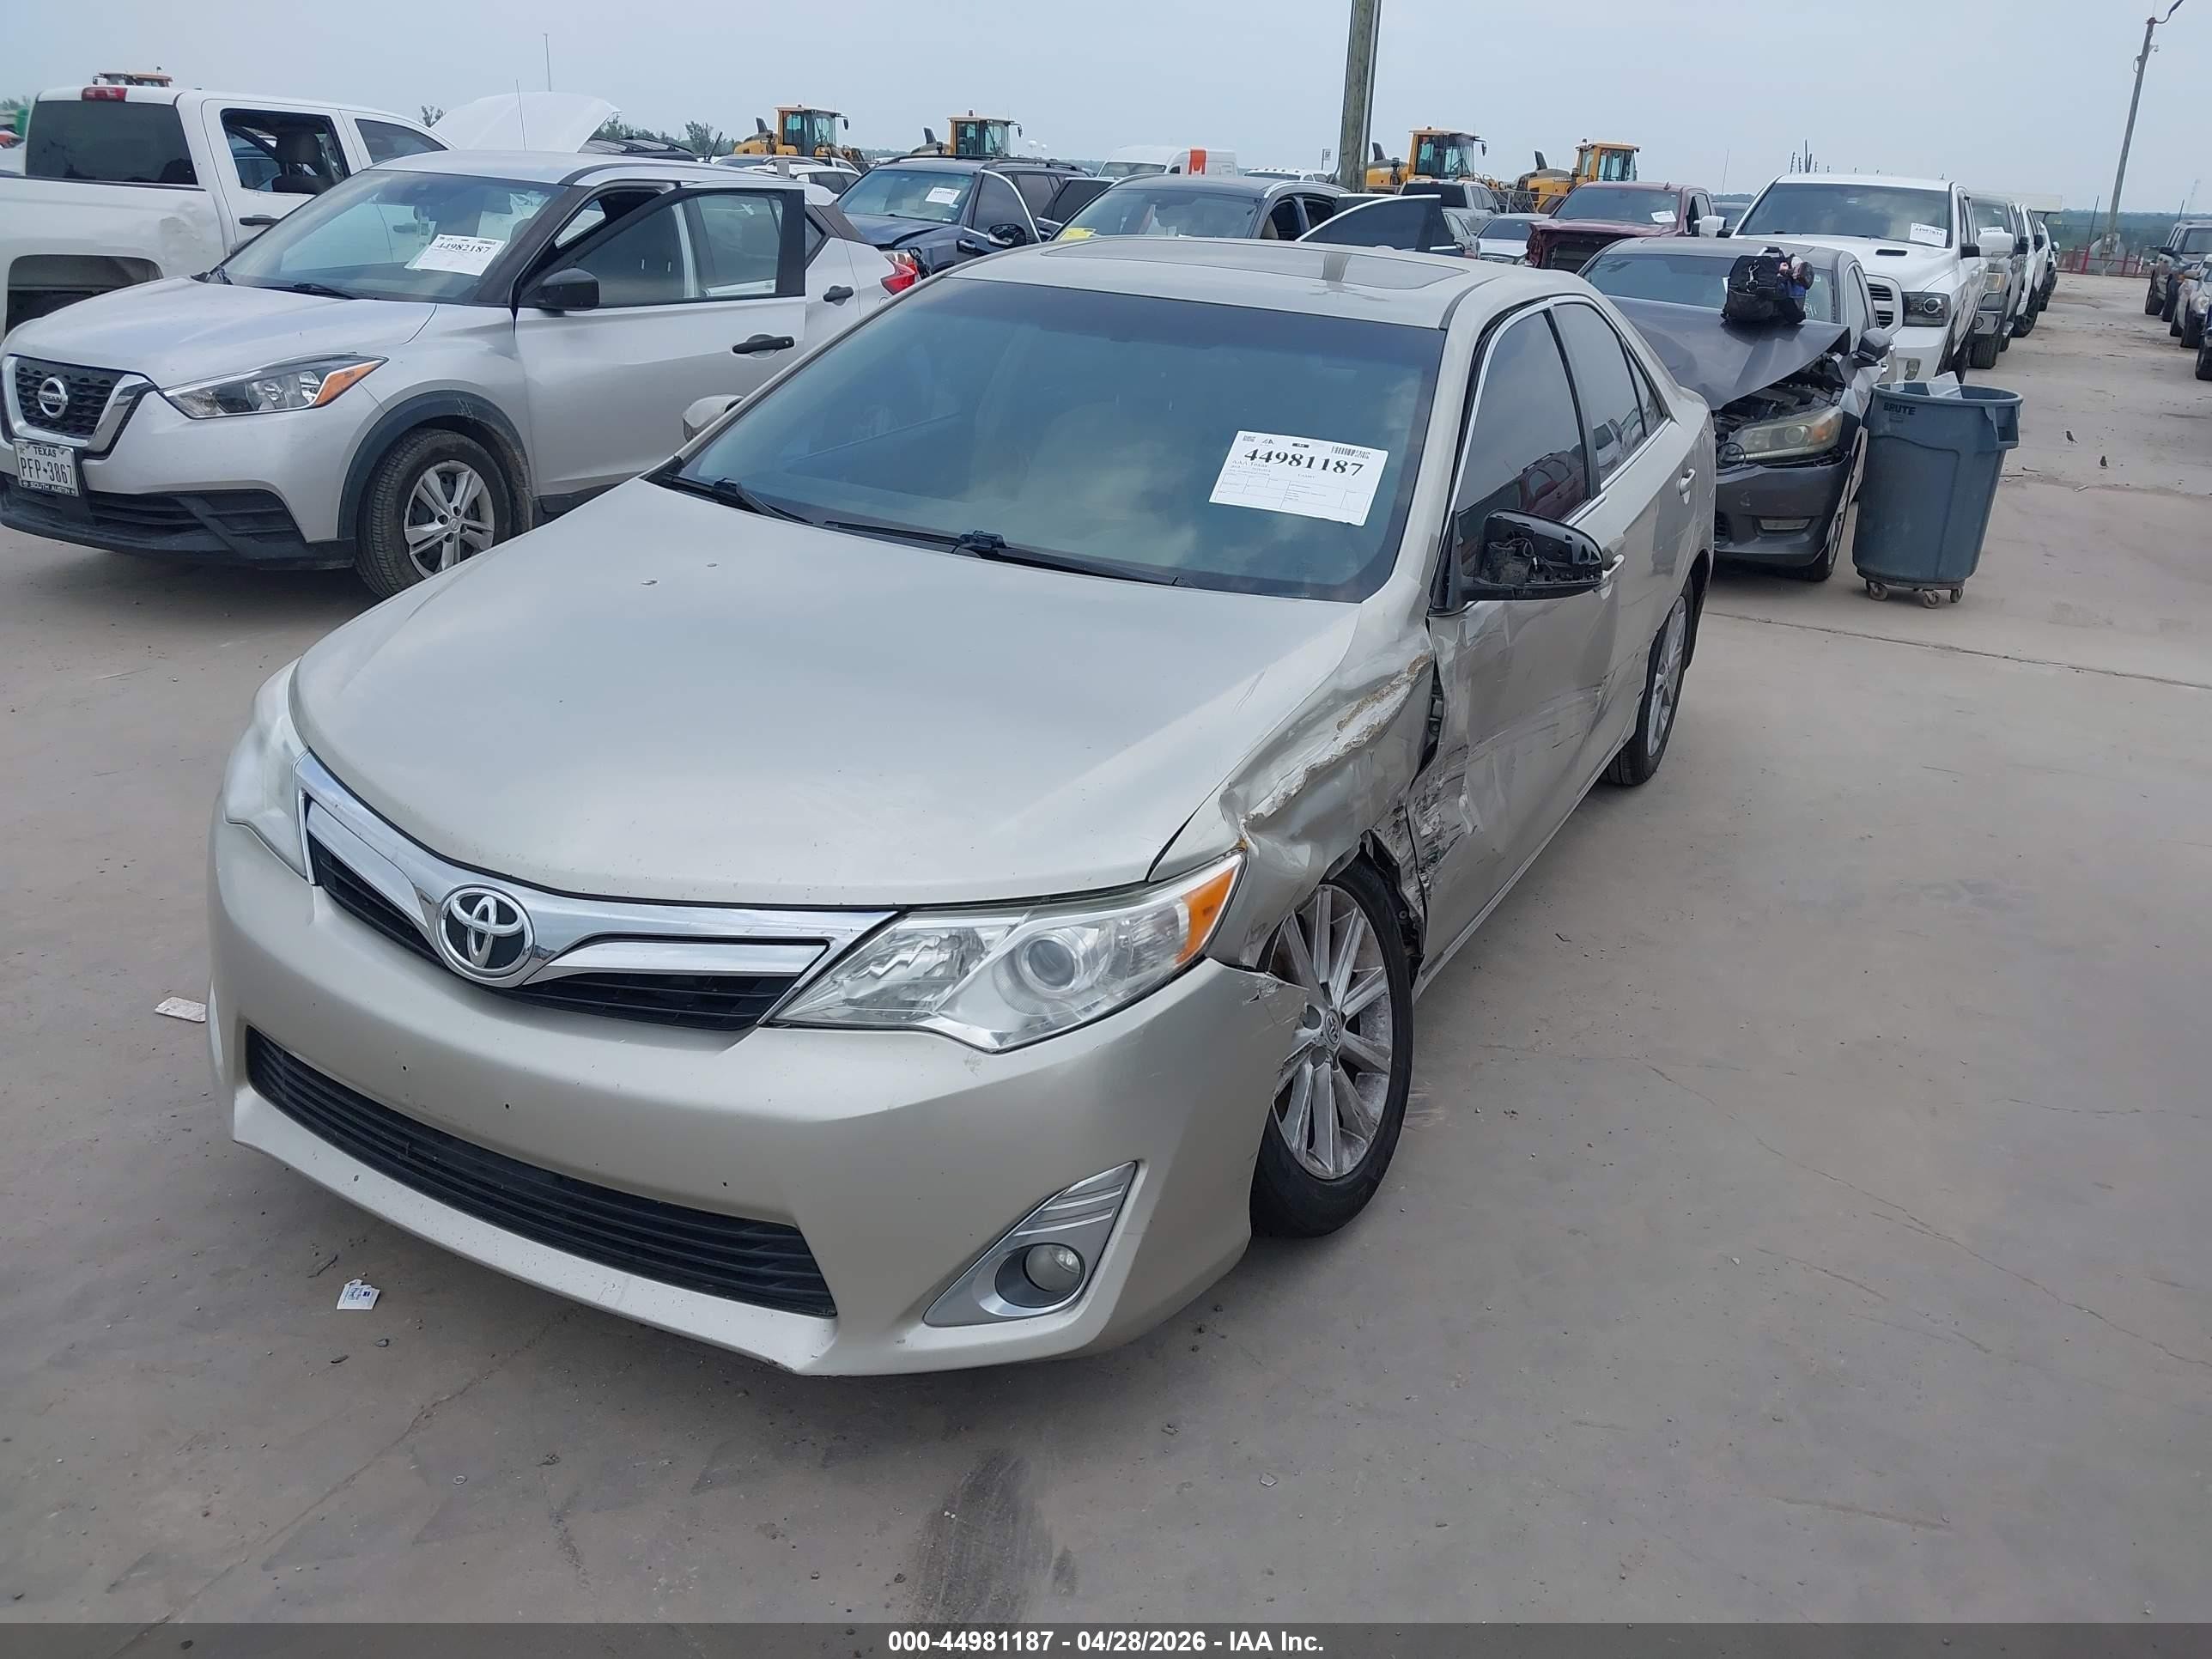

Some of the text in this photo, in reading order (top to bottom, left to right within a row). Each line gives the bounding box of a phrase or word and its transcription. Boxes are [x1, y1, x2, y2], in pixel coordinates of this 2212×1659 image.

[1883, 402, 1916, 416] BRUTE
[33, 446, 57, 458] TEXAS
[1244, 447, 1365, 477] 44981187
